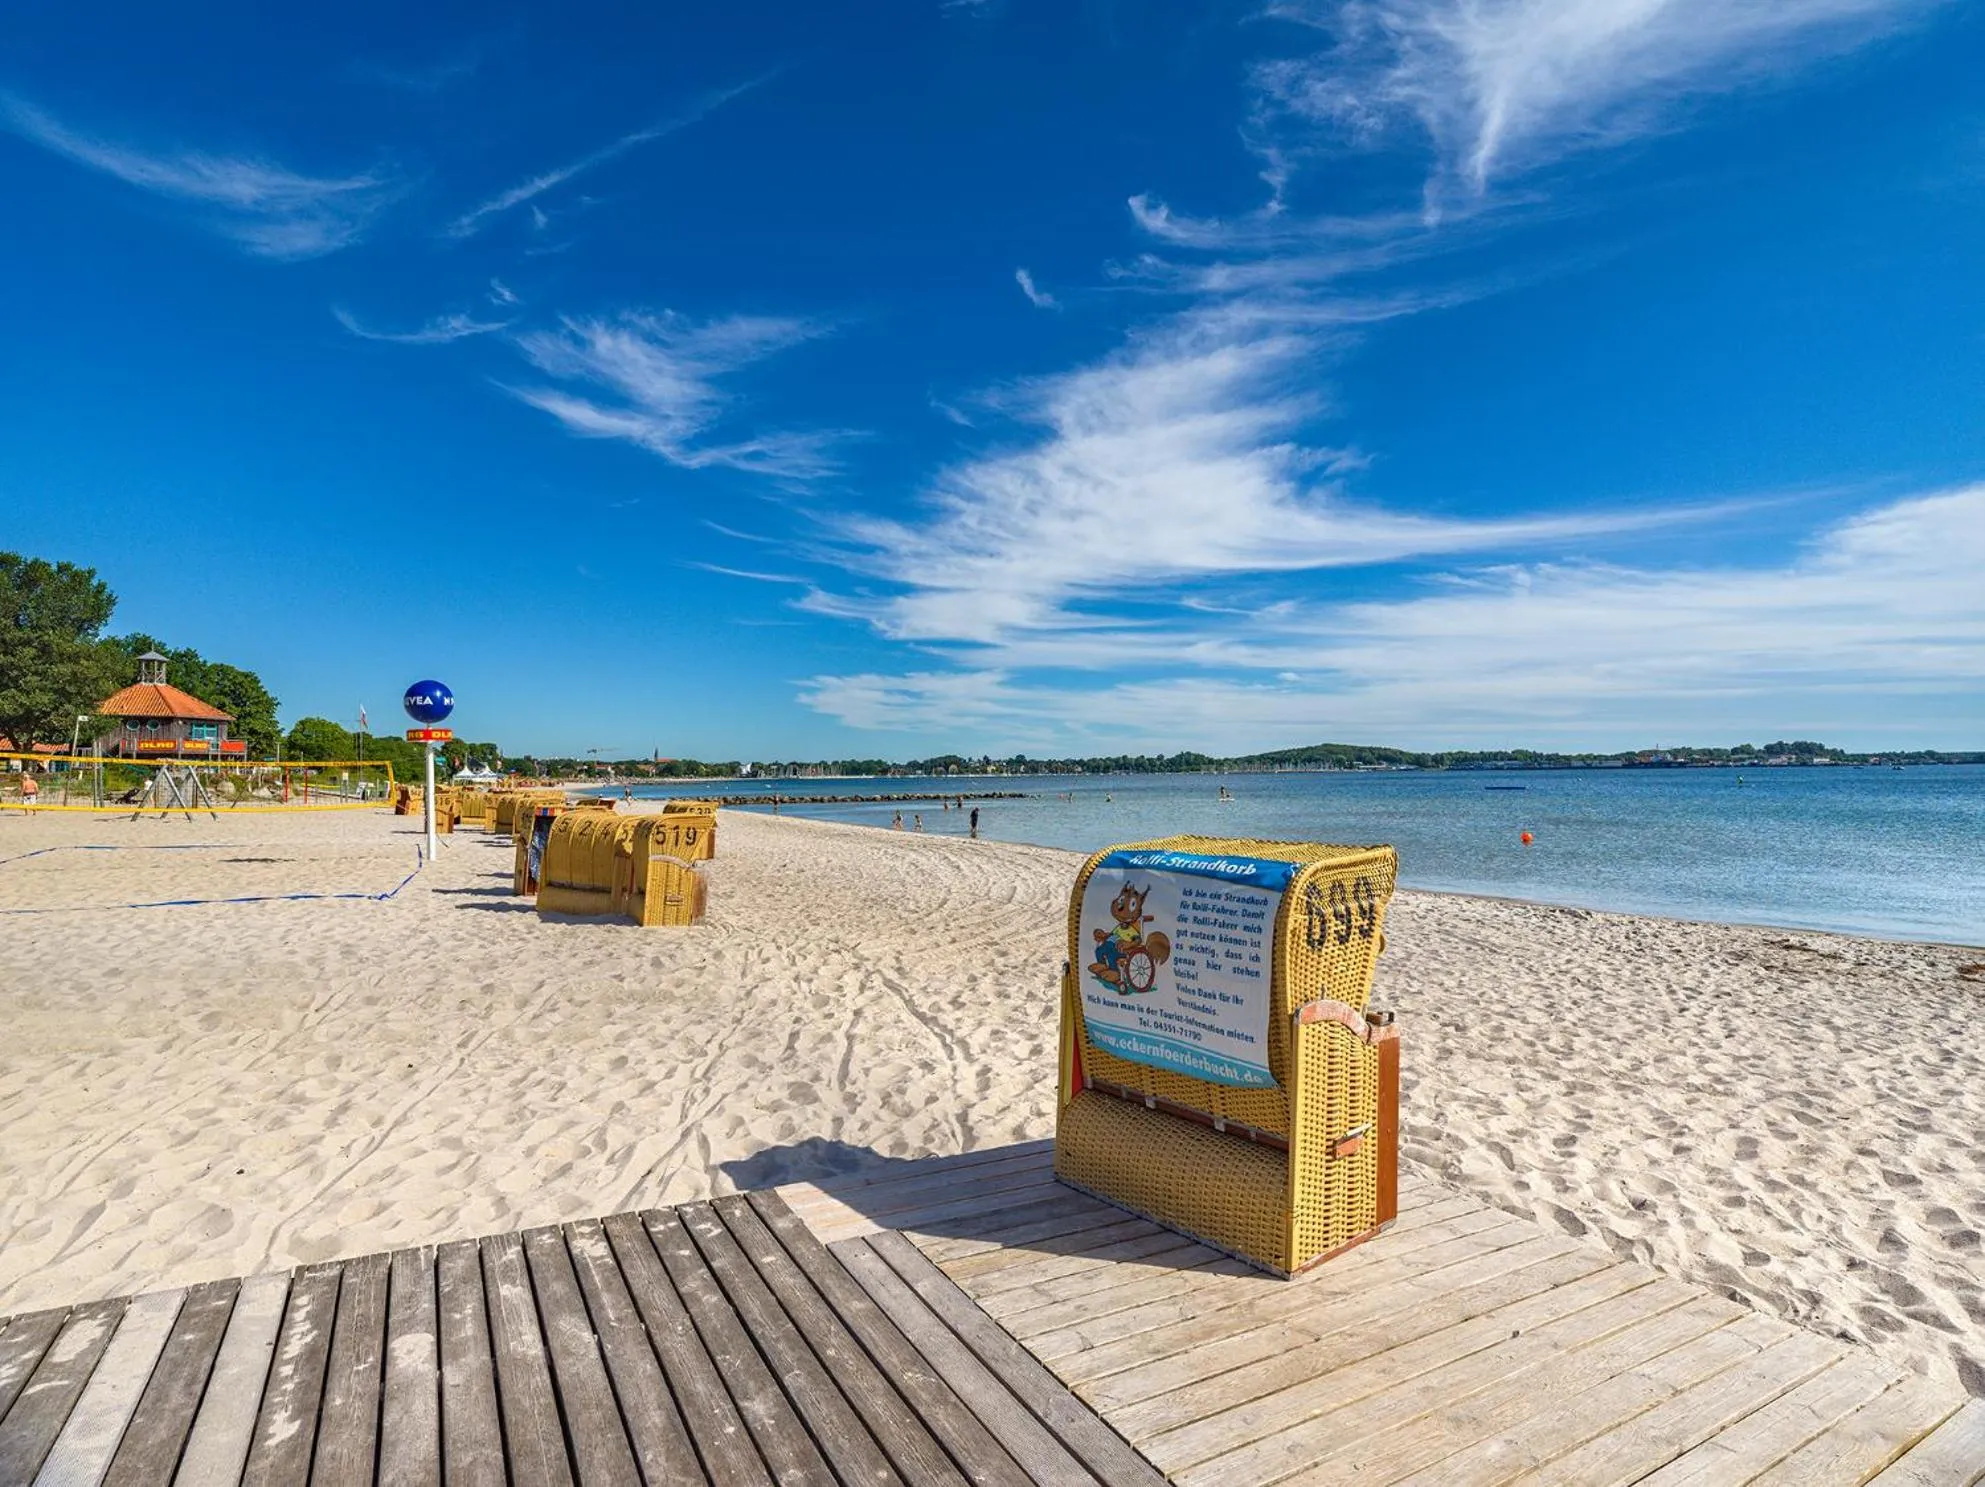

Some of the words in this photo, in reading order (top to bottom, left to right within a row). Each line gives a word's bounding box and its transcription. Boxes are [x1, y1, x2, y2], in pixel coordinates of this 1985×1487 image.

[655, 824, 697, 847] 519
[1129, 854, 1257, 875] Rolli-Strandkorb
[1224, 892, 1268, 906] Strandkorb
[1176, 914, 1188, 923] die
[1243, 923, 1262, 934] mich
[1241, 909, 1265, 919] Damit
[1176, 929, 1188, 938] gut
[1190, 931, 1216, 942] nutzen
[1219, 933, 1248, 947] können
[1250, 938, 1261, 949] ist
[1224, 949, 1242, 960] dass
[1249, 952, 1261, 963] ich
[1173, 956, 1196, 967] genau
[1206, 960, 1222, 971] hier
[1232, 966, 1260, 978] stehen
[1175, 982, 1196, 996] Vielen
[1197, 988, 1217, 1000] Dank
[1219, 992, 1231, 1003] für
[1232, 994, 1244, 1006] Ihr
[1103, 997, 1119, 1008] kann
[1120, 1003, 1136, 1011] man
[1137, 1004, 1144, 1013] in
[1146, 1006, 1158, 1016] der
[1139, 1017, 1152, 1028] Tel.
[1092, 1030, 1264, 1083] www.eckernfoerderbucht.de
